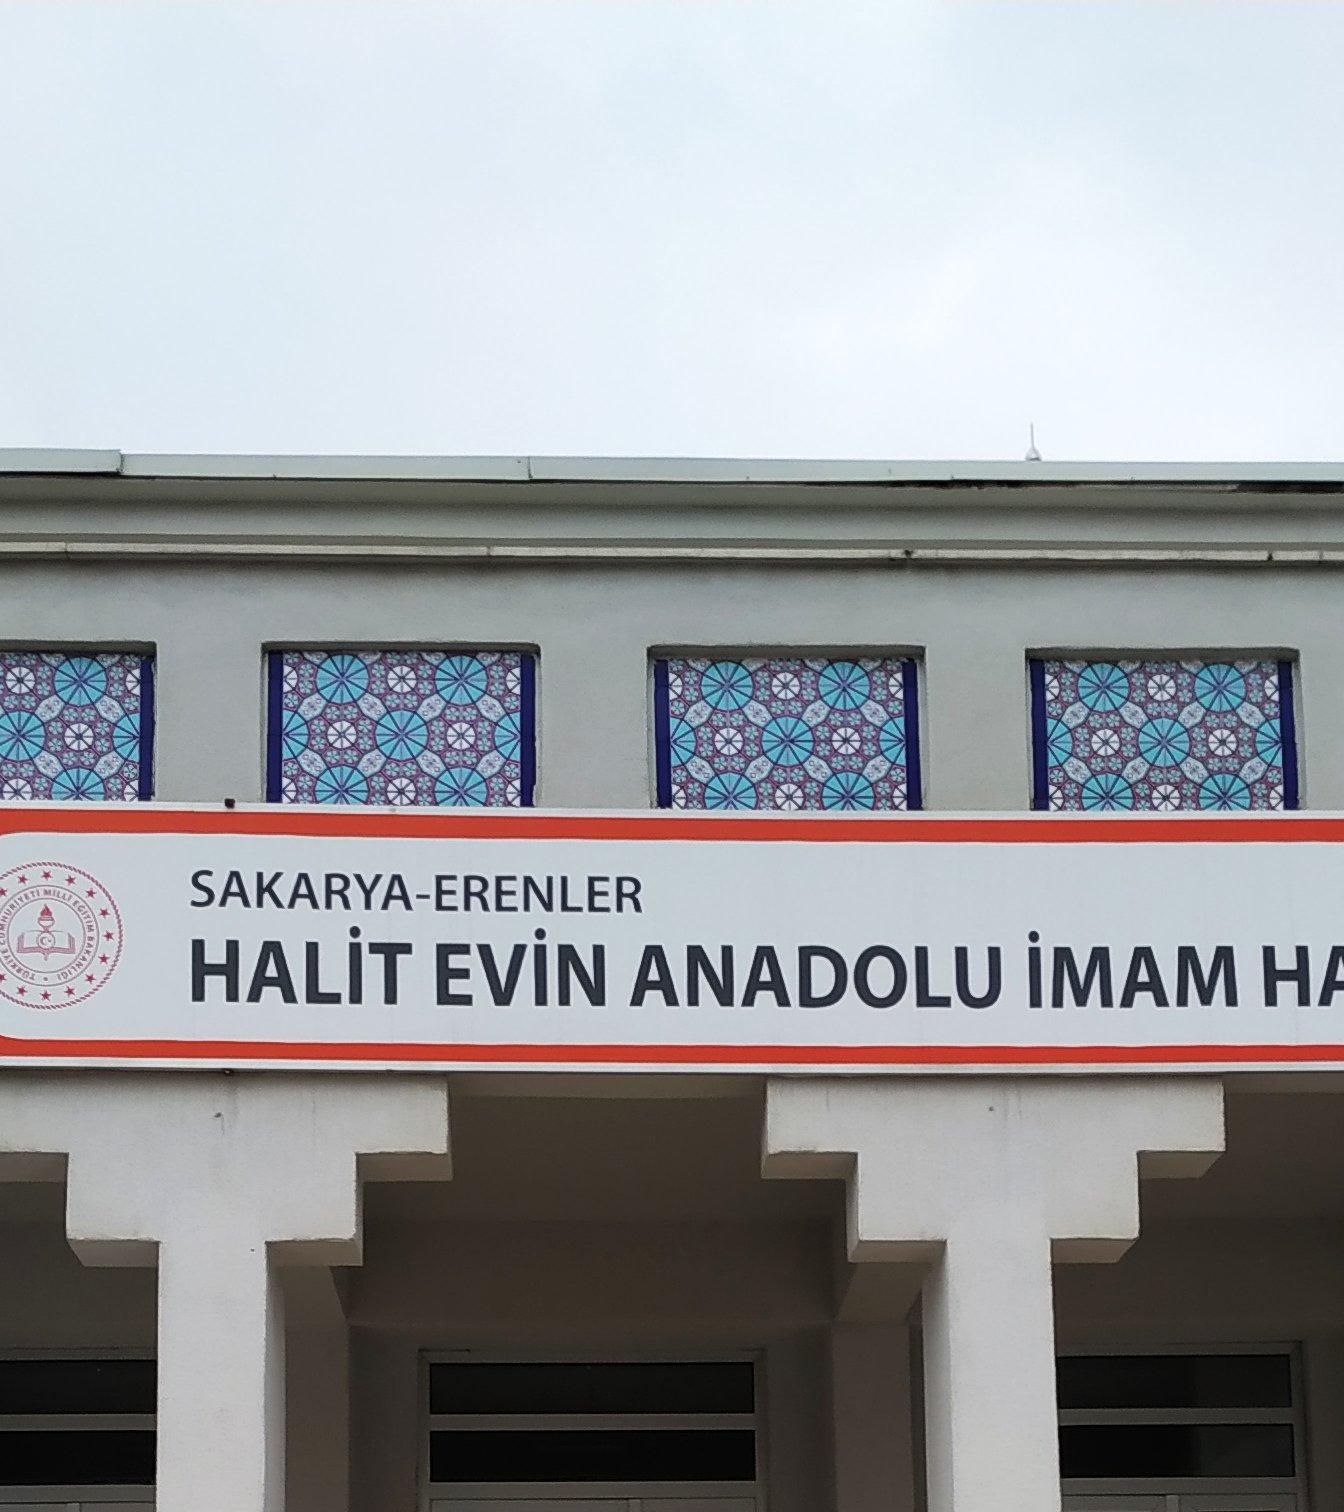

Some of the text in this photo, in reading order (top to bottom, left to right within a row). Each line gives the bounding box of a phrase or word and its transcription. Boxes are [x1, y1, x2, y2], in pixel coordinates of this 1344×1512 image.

[190, 869, 643, 914] SAKARYA-ERENLER
[191, 925, 413, 1005] HALİT
[435, 927, 606, 1007] EVİN
[629, 944, 1002, 1010] ANADOLU
[1027, 930, 1239, 1009] İMAM
